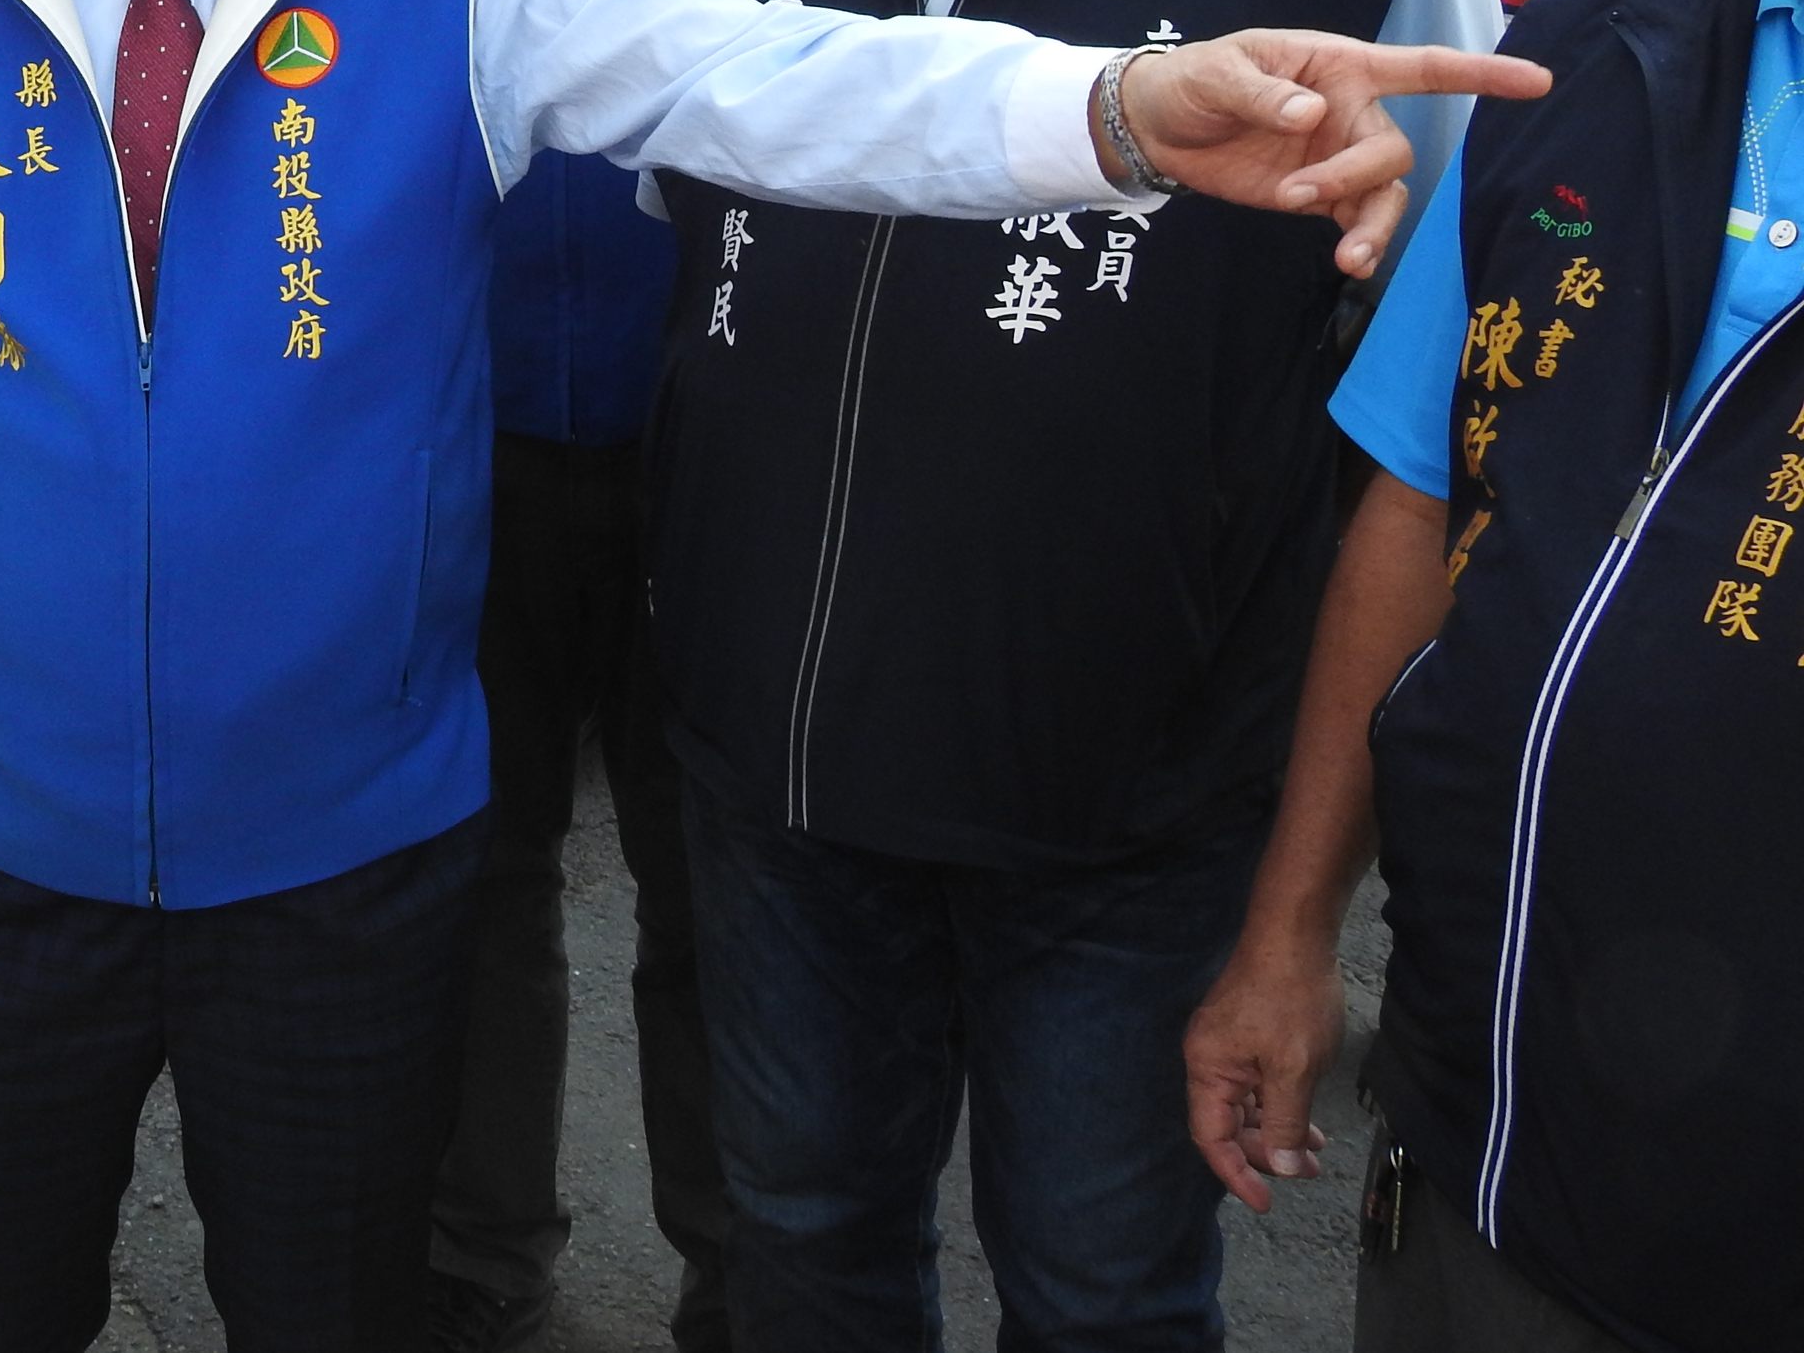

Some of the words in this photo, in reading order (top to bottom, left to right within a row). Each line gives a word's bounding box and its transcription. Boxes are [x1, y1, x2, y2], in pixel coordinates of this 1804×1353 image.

[14, 58, 61, 176] 縣長
[271, 97, 331, 361] 南投縣政府
[1535, 255, 1605, 379] 秘書
